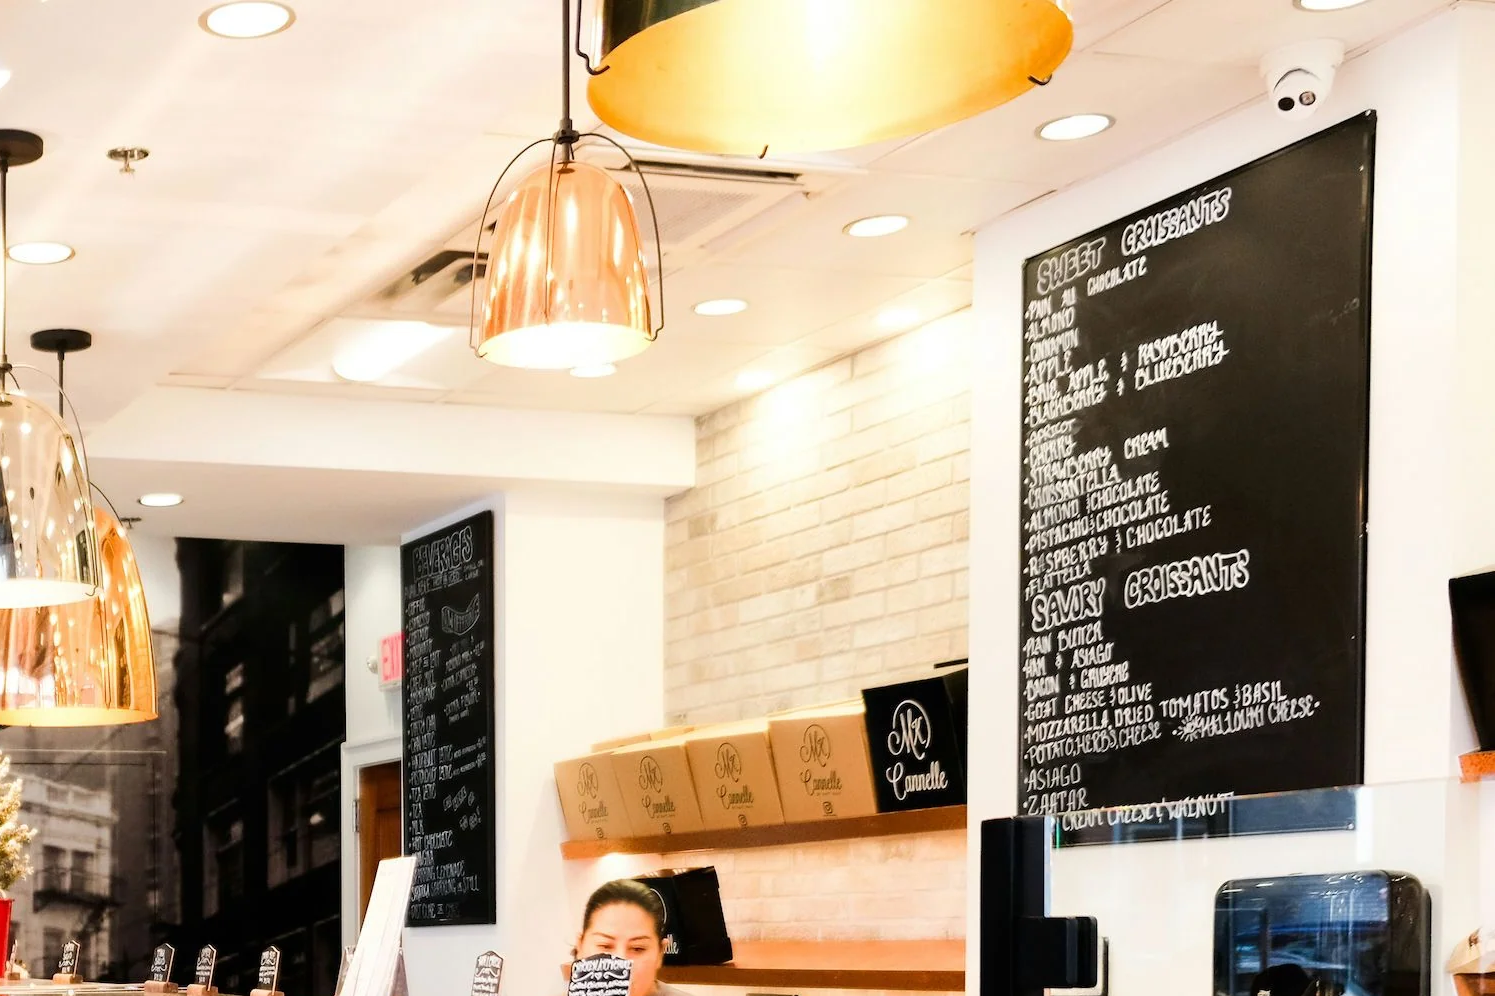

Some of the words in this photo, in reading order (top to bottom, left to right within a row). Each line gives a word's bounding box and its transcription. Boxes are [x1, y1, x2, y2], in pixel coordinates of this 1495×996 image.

[1037, 237, 1106, 295] SWEET
[1121, 187, 1232, 256] CROISSANTS
[1027, 308, 1074, 341] ALMOND
[1138, 320, 1224, 368] RASPBERRY
[1028, 350, 1073, 387] APPLE
[1135, 340, 1230, 391] BLUEBERRY
[1029, 434, 1078, 468] CHERRY
[1030, 446, 1112, 487] STRAWBERRY
[1124, 427, 1170, 460] CREAM
[1096, 490, 1170, 533] CHOCOLATE
[1028, 535, 1110, 578] RASPBERRY
[1126, 504, 1212, 549] CHOCOLATE
[1031, 577, 1106, 632] SAVORY
[1124, 549, 1249, 609] CROISSANTS
[1071, 642, 1114, 669] ASIAGO
[1065, 690, 1107, 715] CHEESE
[1114, 704, 1154, 728] DRIED
[1159, 688, 1229, 718] TOMATOS
[1267, 694, 1315, 724] CHEESE
[716, 784, 754, 810] Cannelle
[800, 768, 843, 796] Cannelle
[885, 761, 948, 801] Cannelle
[1027, 763, 1082, 793] ASIAGO
